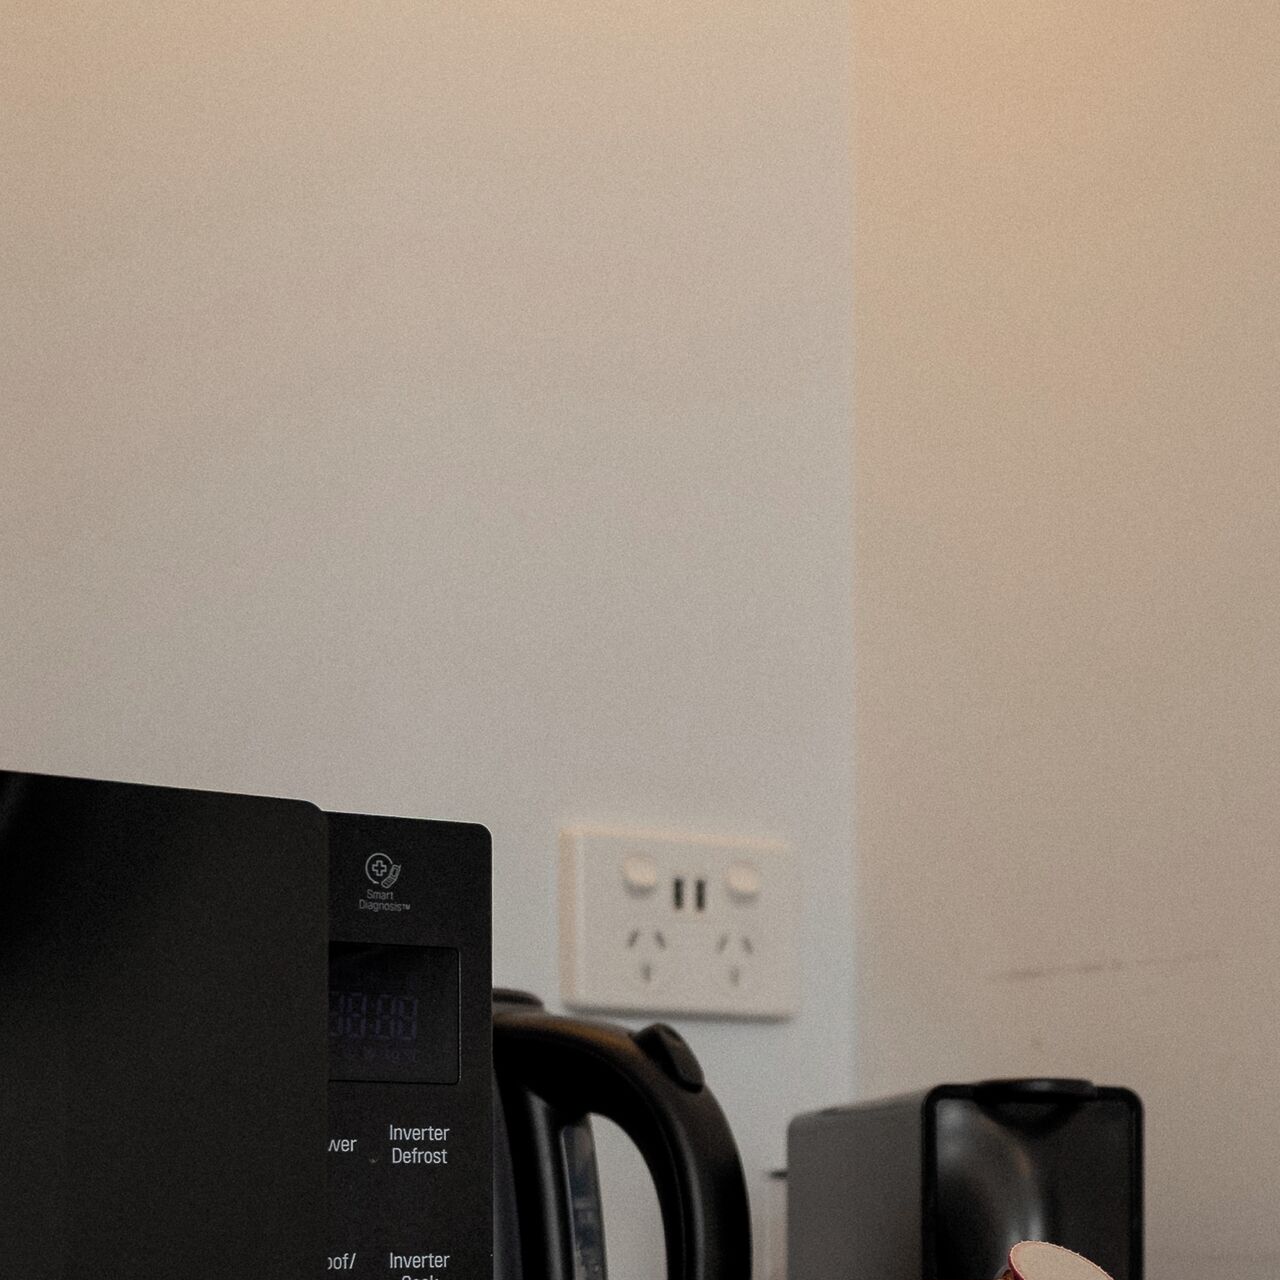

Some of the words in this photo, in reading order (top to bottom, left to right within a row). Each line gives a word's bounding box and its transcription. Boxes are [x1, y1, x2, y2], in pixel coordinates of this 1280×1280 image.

[366, 888, 394, 900] Smart
[389, 1124, 450, 1141] Inverter
[392, 1147, 448, 1165] Defrost
[389, 1252, 450, 1269] Inverter
